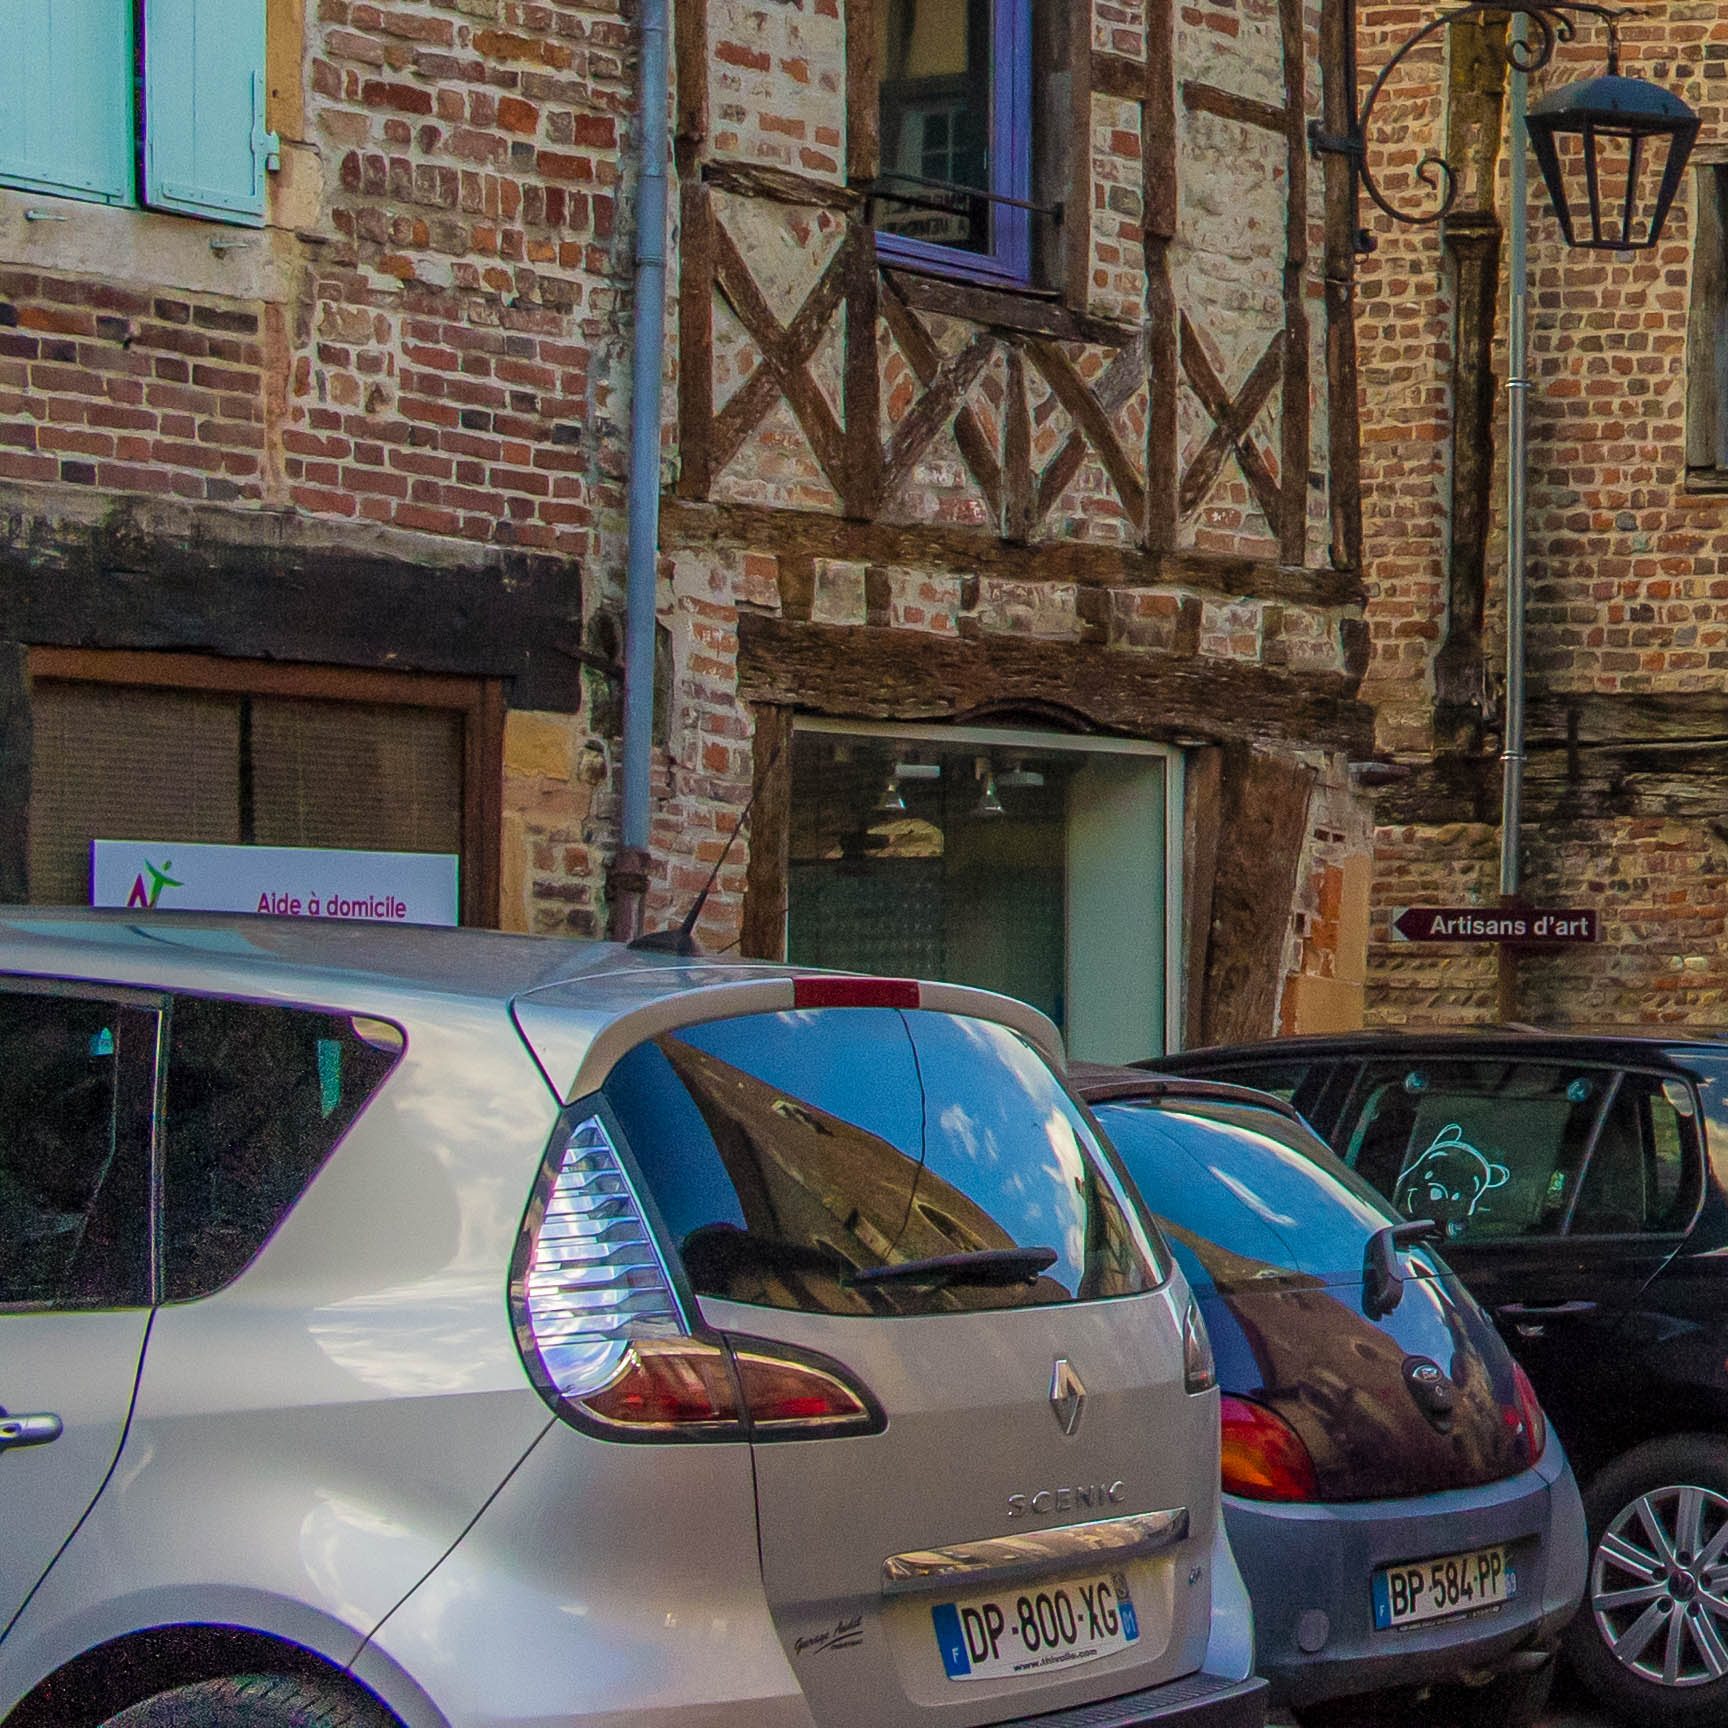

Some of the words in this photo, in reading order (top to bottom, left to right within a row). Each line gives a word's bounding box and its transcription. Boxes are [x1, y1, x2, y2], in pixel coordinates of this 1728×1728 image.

[256, 892, 301, 916] Aide
[307, 891, 320, 917] à
[326, 893, 407, 919] domicile
[1429, 914, 1527, 936] Artisans
[1533, 915, 1589, 936] d'art
[1006, 1480, 1127, 1518] SCENIC
[1390, 1551, 1501, 1617] BP-584-PP
[951, 1647, 960, 1665] F
[960, 1582, 1120, 1665] DP-800-XG
